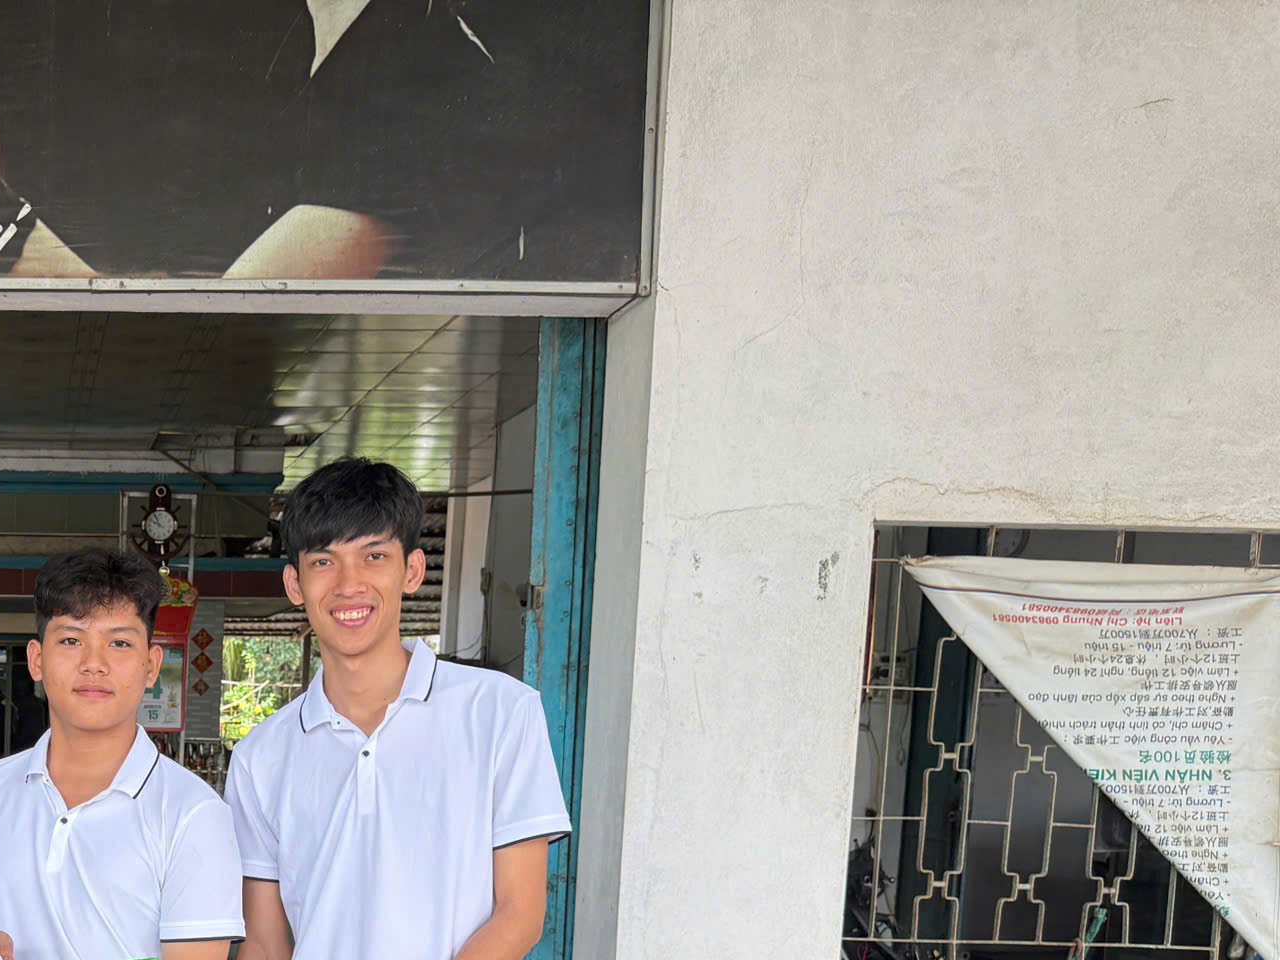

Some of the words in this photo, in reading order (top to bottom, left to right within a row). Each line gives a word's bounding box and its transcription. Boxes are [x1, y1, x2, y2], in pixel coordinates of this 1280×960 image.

[992, 613, 1059, 624] 0983400581
[1063, 615, 1100, 625] Nhung
[1156, 617, 1182, 626] Liên
[1084, 641, 1109, 651] triệu
[1112, 642, 1125, 651] 15
[1137, 640, 1162, 651] triệu
[1166, 643, 1172, 651] 7
[1195, 640, 1236, 651] Lương
[1053, 665, 1080, 678] tiếng
[1085, 668, 1097, 676] 24
[1163, 669, 1176, 677] 12
[1180, 667, 1203, 677] việc
[1207, 668, 1229, 677] Làm
[1028, 692, 1049, 702] đạo
[1053, 694, 1077, 703] lãnh
[1082, 694, 1102, 704] của
[1153, 692, 1168, 701] sự
[1172, 694, 1194, 703] theo
[1198, 693, 1226, 703] Nghe
[148, 709, 158, 720] 15
[1069, 721, 1097, 729] trách
[1152, 721, 1165, 730] có
[1124, 734, 1146, 745] việc
[1150, 734, 1177, 744] công
[1204, 736, 1225, 745] Yêu
[1139, 750, 1232, 764] 检验员100名
[1122, 769, 1159, 784] VIÊN
[1165, 770, 1212, 784] NHÂN
[1219, 770, 1231, 781] 3.
[1132, 797, 1154, 807] triệu
[1159, 799, 1164, 807] 7
[1186, 797, 1223, 807] Lương
[1155, 824, 1166, 833] 12
[1171, 823, 1192, 833] việc
[1191, 849, 1218, 859] Nghe
